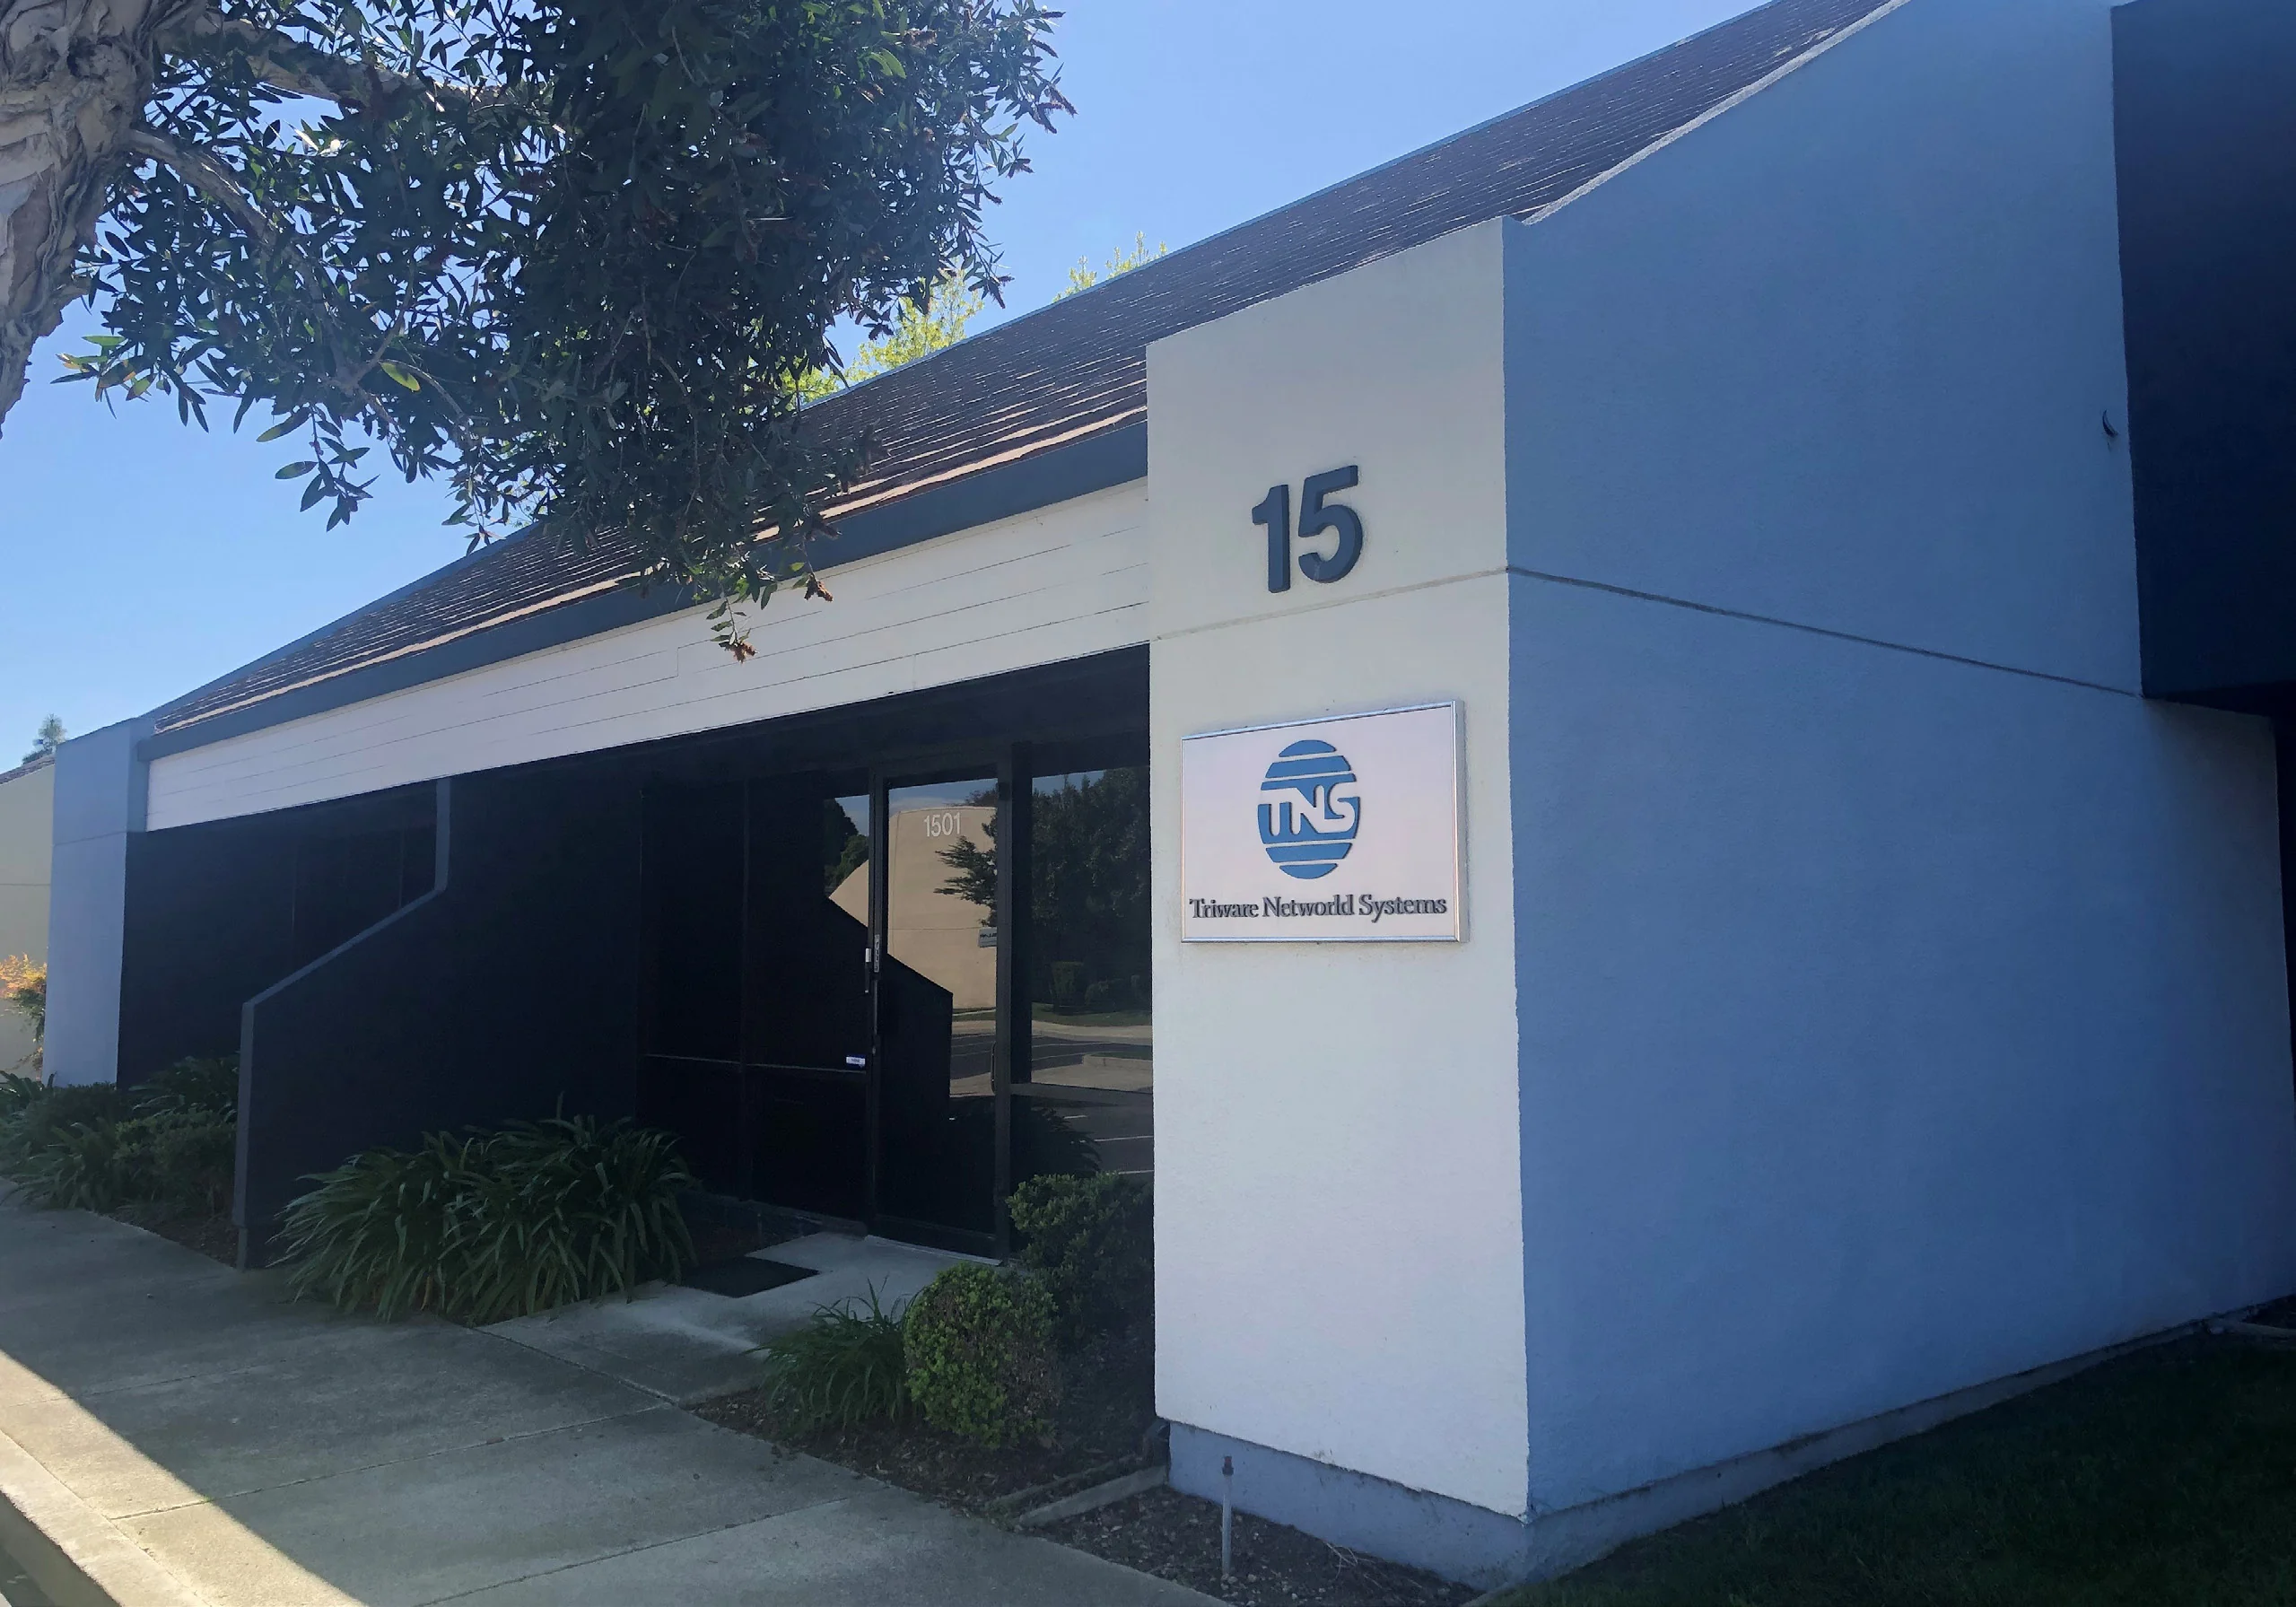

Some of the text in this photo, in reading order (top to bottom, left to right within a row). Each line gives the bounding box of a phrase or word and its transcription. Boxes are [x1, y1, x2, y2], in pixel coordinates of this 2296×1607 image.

[1252, 465, 1363, 593] 15
[924, 812, 961, 837] 1501
[1258, 782, 1360, 836] TNS
[1189, 894, 1447, 923] Triware Networld Systems
